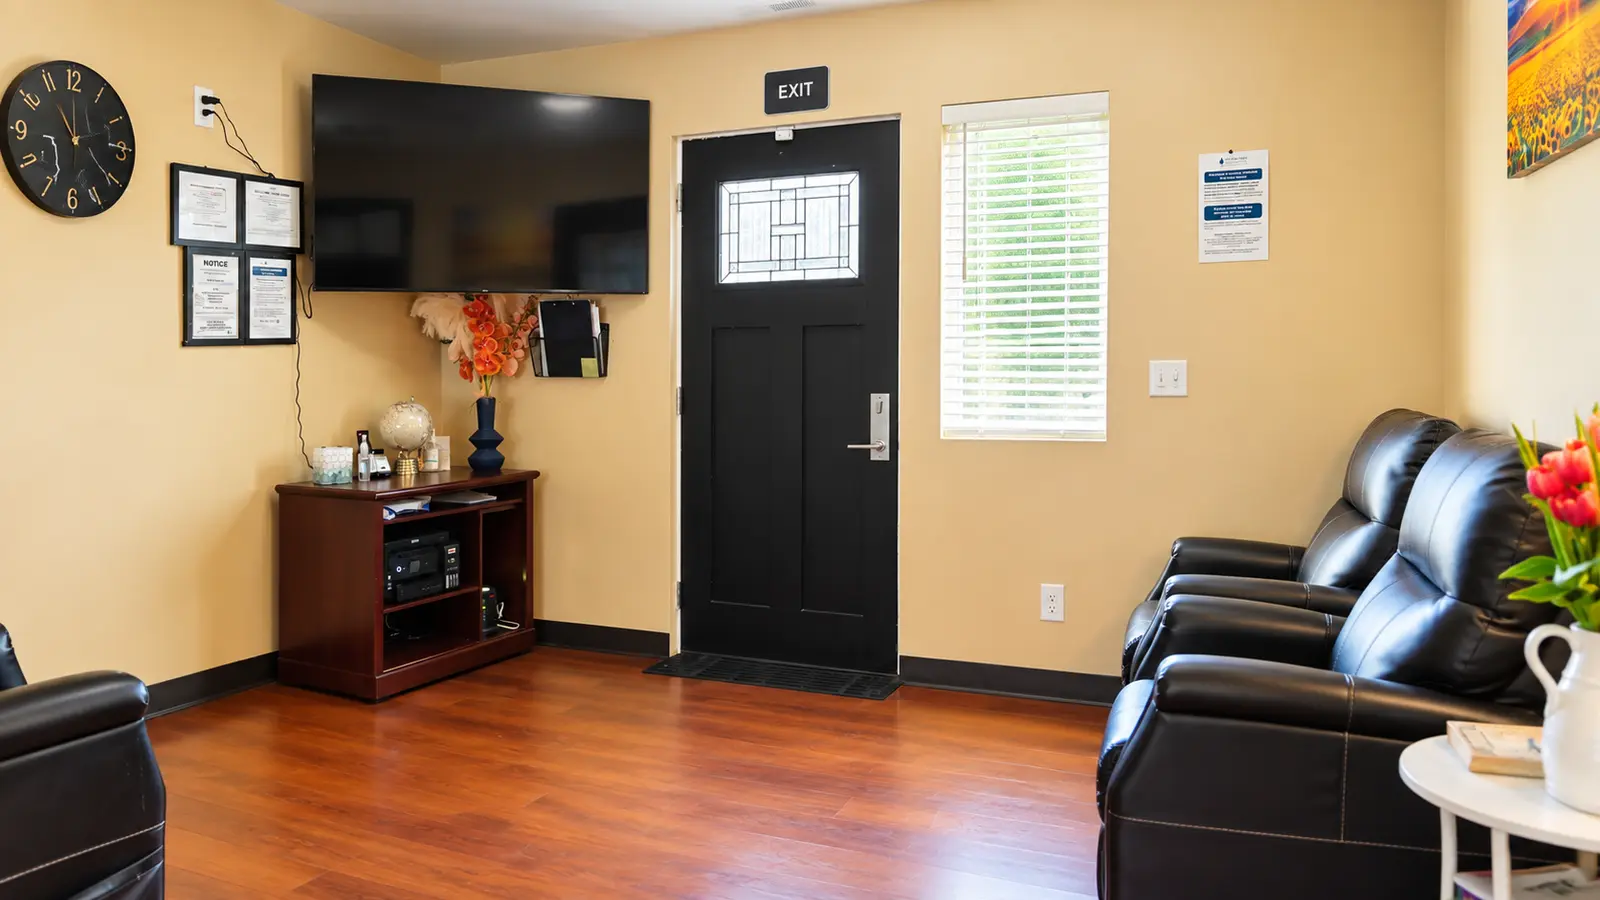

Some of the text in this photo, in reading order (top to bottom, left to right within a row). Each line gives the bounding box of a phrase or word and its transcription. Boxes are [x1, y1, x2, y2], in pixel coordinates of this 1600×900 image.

[66, 68, 82, 93] 12
[778, 81, 814, 100] EXIT
[15, 119, 28, 141] 9
[67, 187, 78, 210] 6
[203, 259, 228, 268] NOTICE
